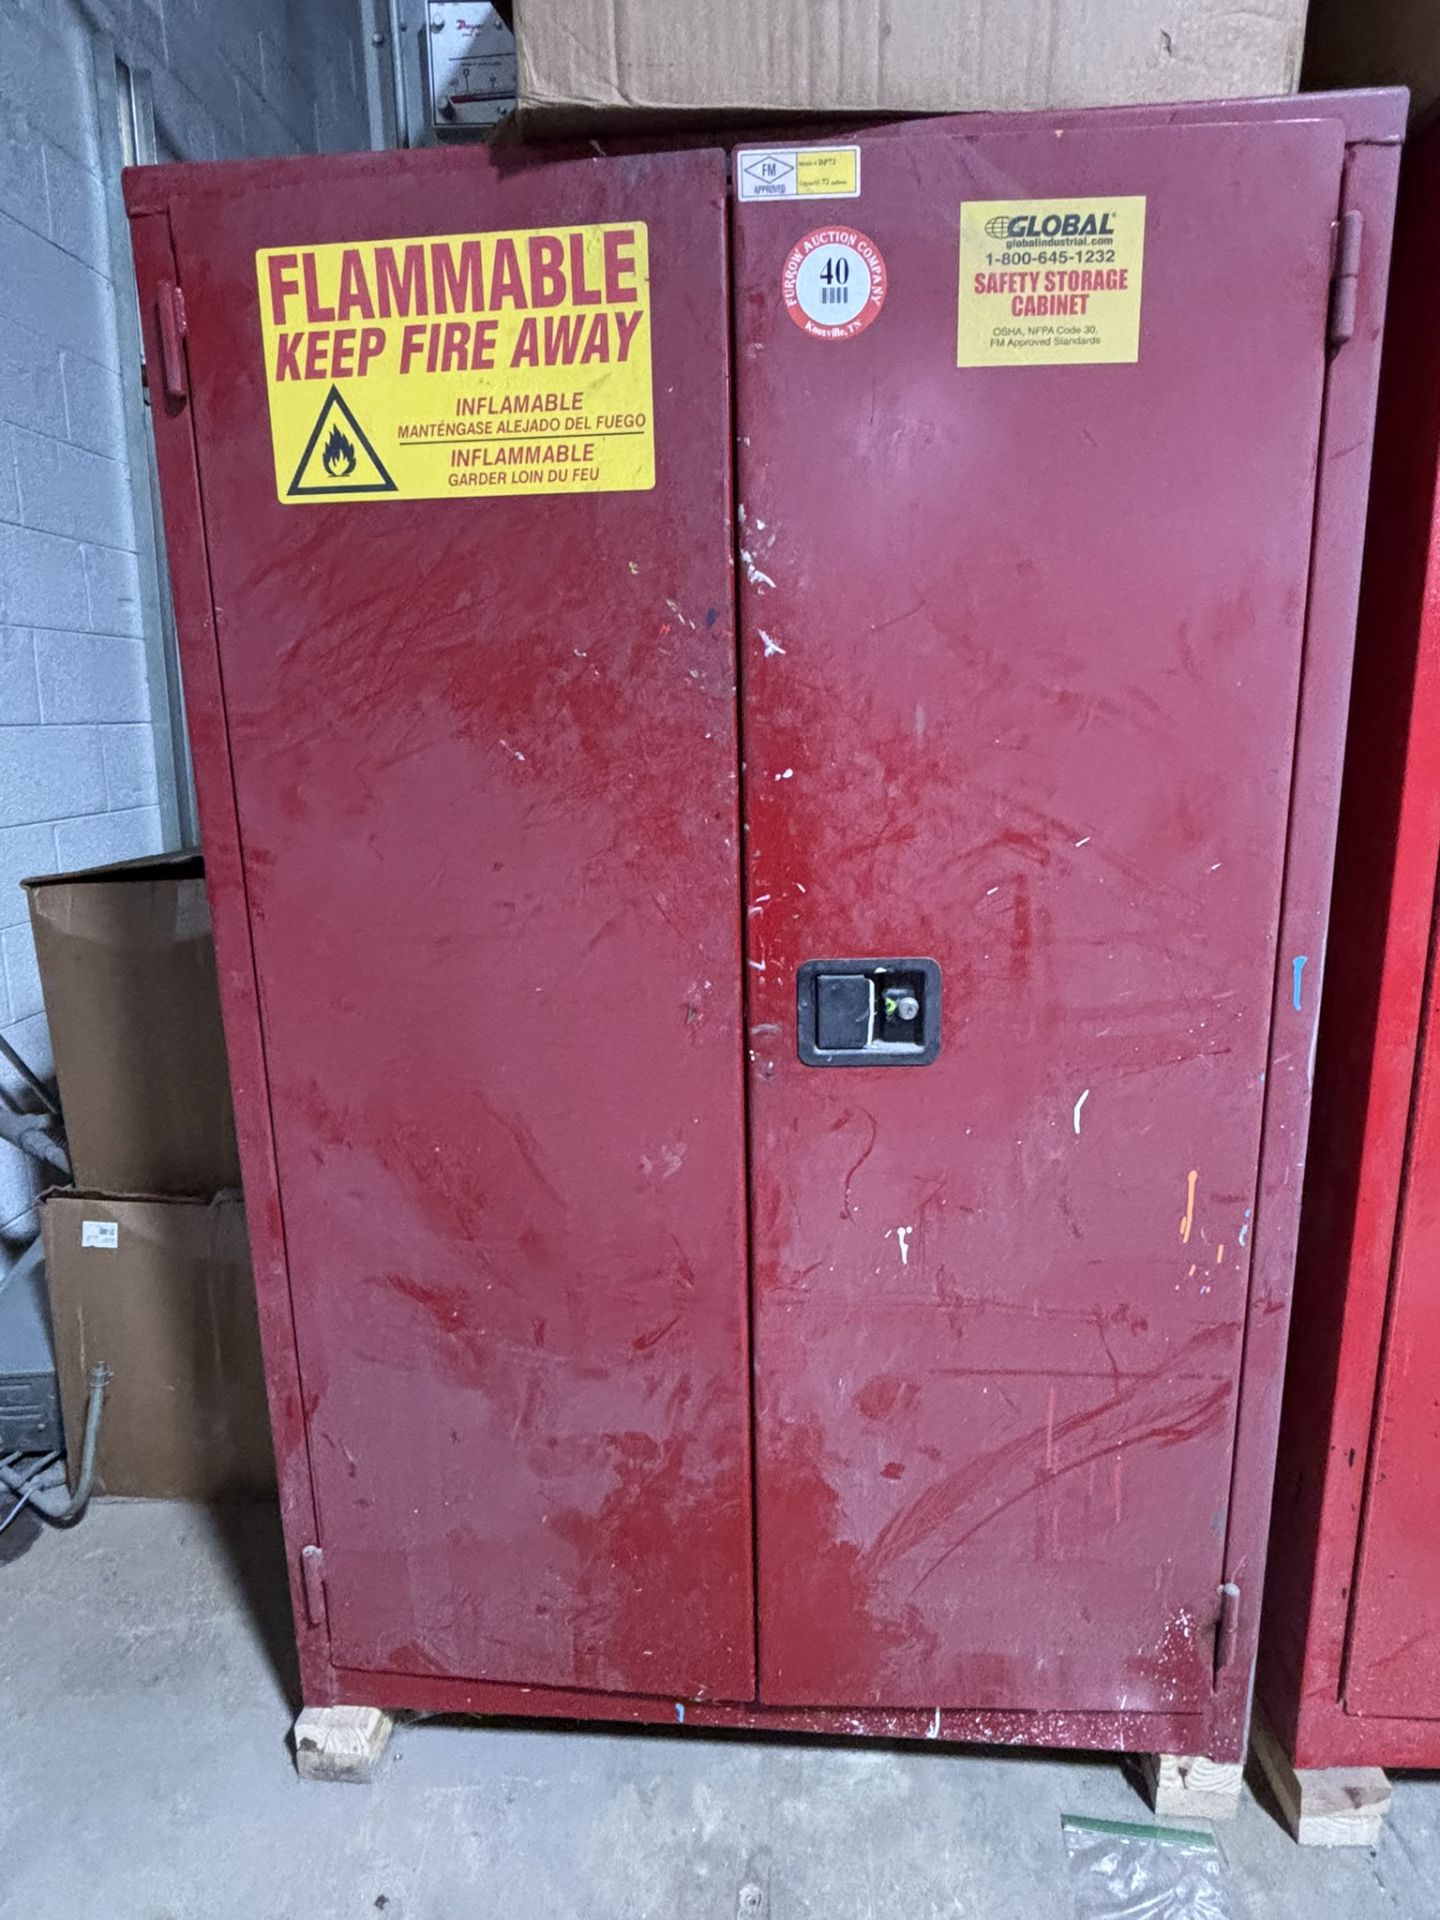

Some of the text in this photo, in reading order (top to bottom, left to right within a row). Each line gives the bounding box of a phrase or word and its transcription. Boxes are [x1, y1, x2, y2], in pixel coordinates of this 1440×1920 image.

[762, 163, 776, 177] FM
[754, 184, 786, 194] APPROVED
[1007, 213, 1114, 237] GLOBAL
[1006, 237, 1113, 250] globalindustrial.com
[784, 231, 884, 306] FURROW AUCTION COMPANY
[986, 250, 1116, 266] 1-800-645-1232
[268, 229, 637, 325] FLAMMABLE
[820, 257, 849, 285] 40
[974, 269, 1129, 294] SAFETY STORAGE
[1011, 294, 1089, 317] CABINET
[990, 336, 1101, 348] FM Approved Standards
[993, 328, 1024, 337] OSHA,
[1028, 327, 1054, 335] NFPA
[1056, 326, 1082, 335] Code
[276, 310, 644, 382] KEEP FIRE AWAY
[456, 392, 584, 416] INFLAMABLE
[398, 413, 646, 439] MANTÉNGASE ALEJADO DEL FUEGO
[451, 444, 595, 467] INFLAMMABLE
[448, 468, 600, 487] GARDER LOIN DU FEU
